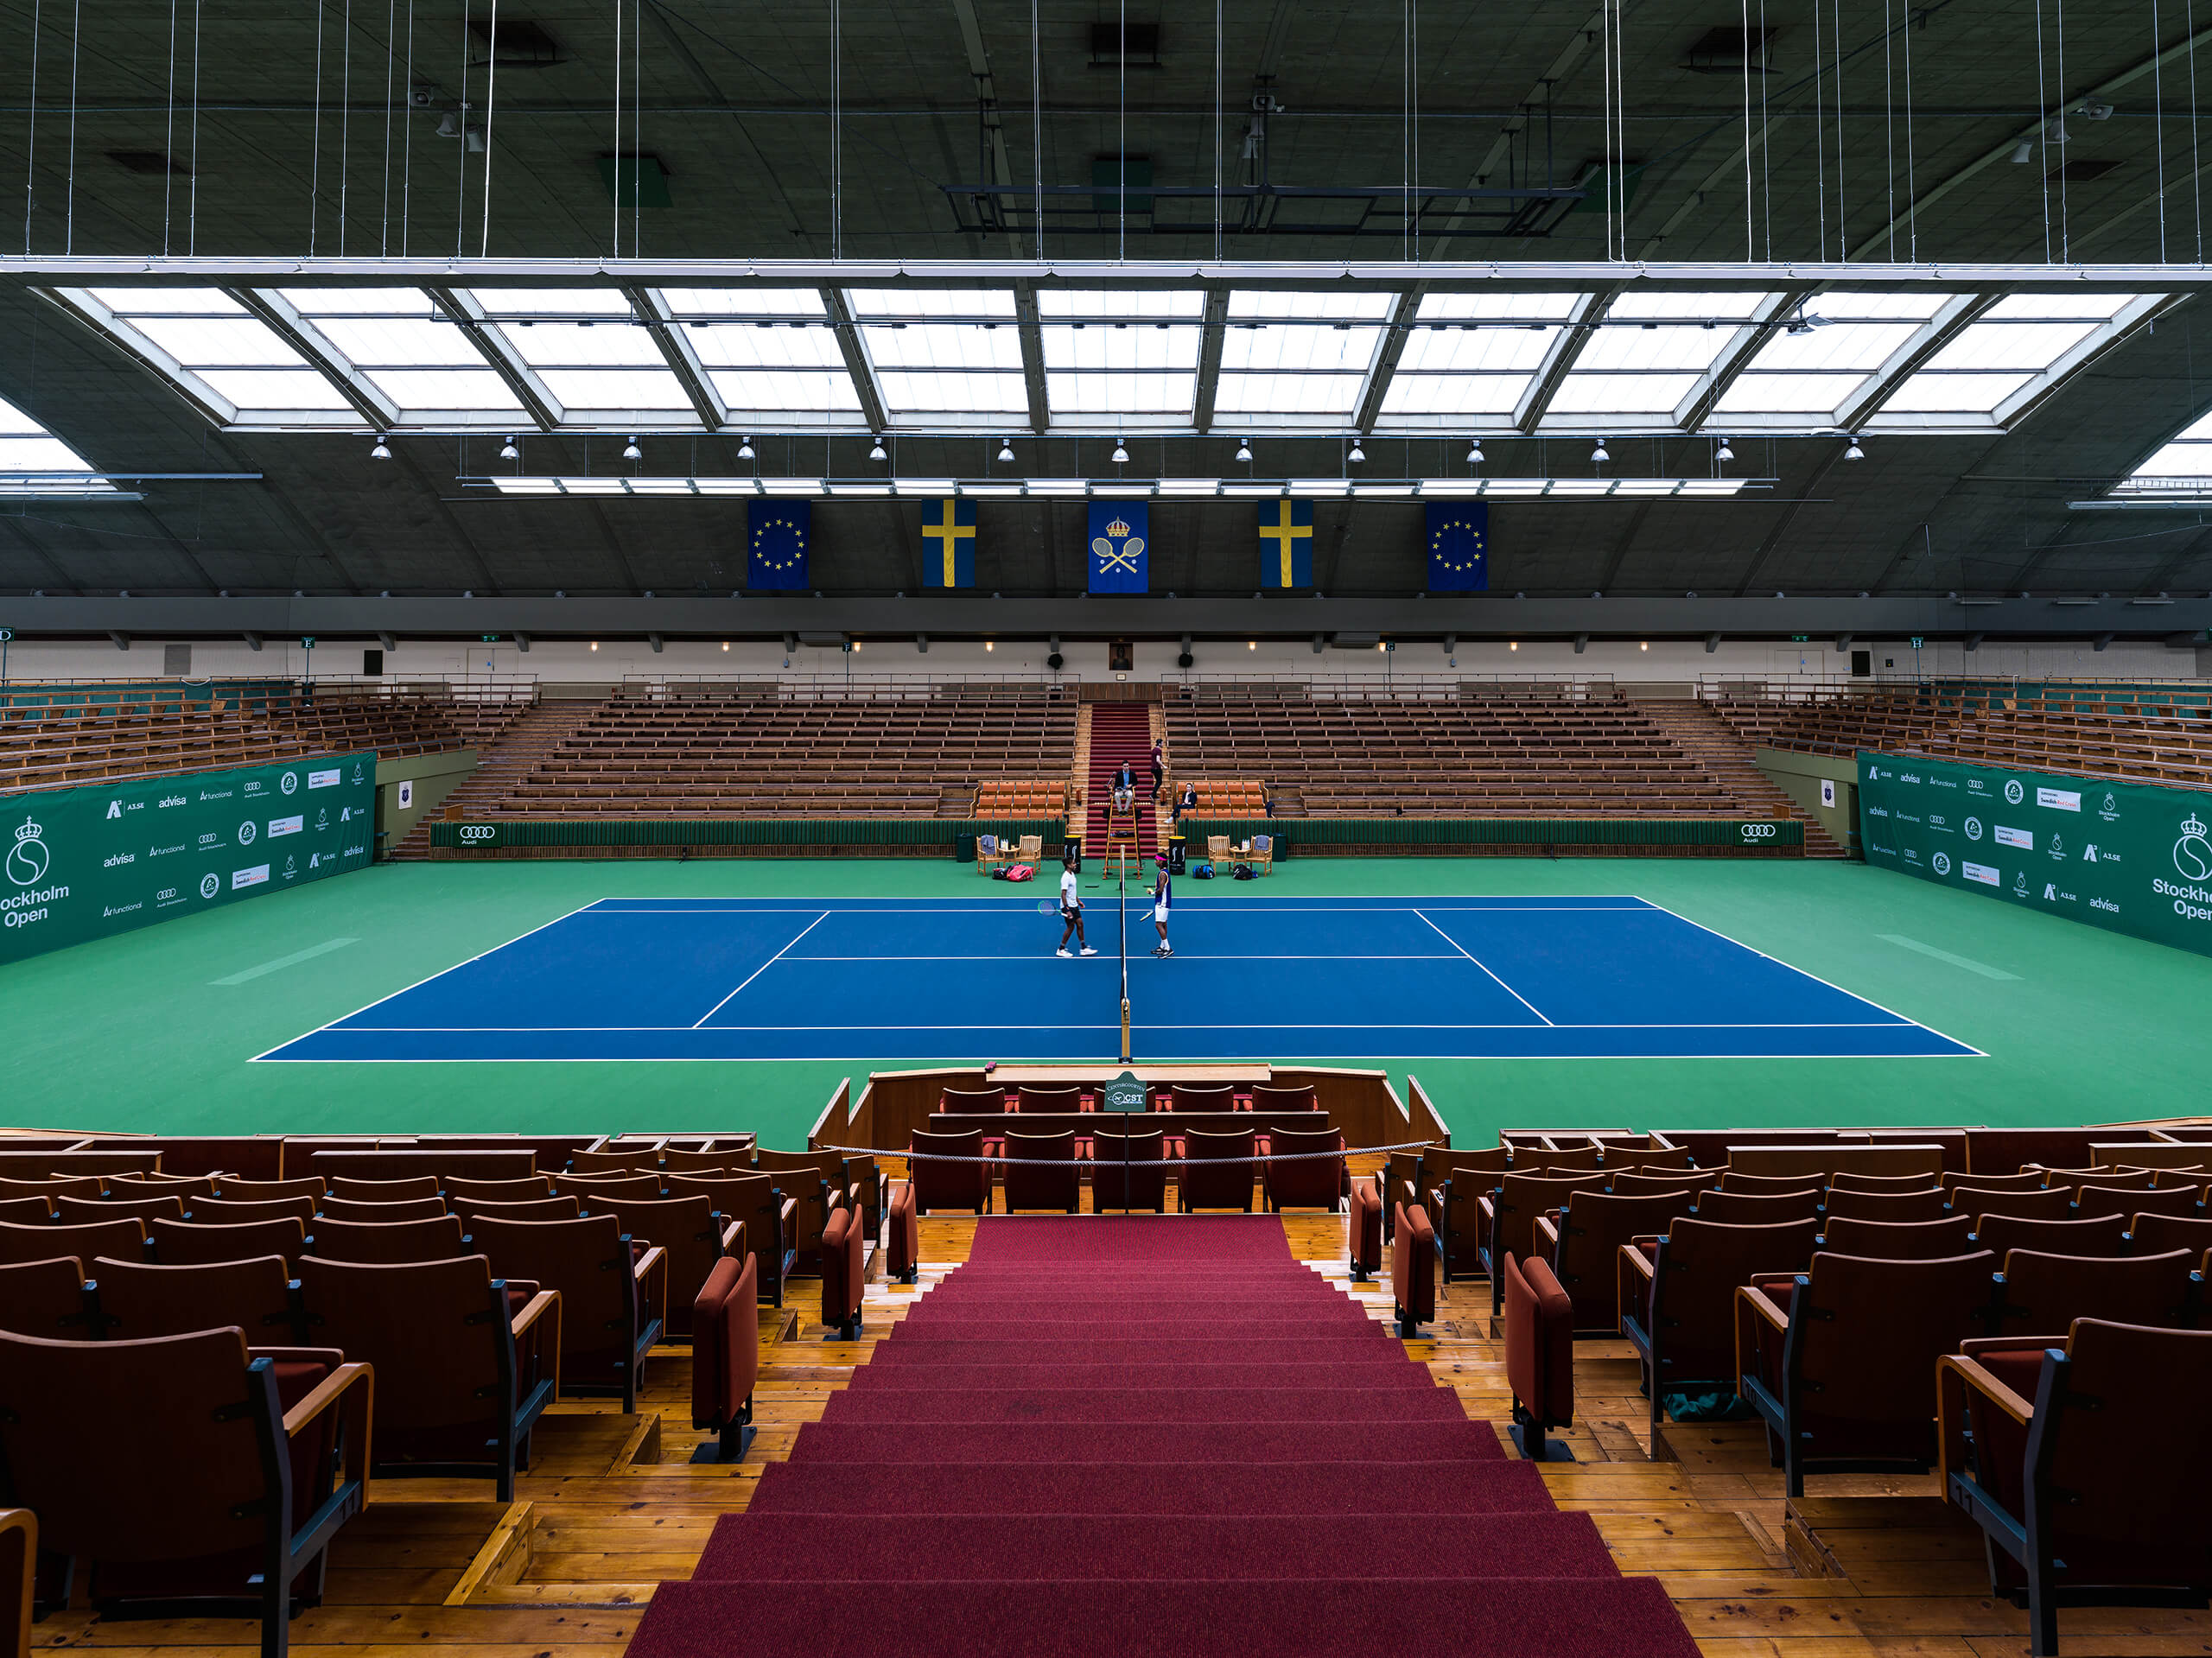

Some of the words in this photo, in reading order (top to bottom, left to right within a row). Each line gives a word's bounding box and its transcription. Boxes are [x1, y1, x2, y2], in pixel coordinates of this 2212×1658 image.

[2102, 852, 2121, 862] A3.SE
[0, 885, 69, 911] ockholm
[2152, 878, 2212, 903] Stockh
[4, 907, 48, 929] Open
[1955, 1485, 1972, 1515] 11
